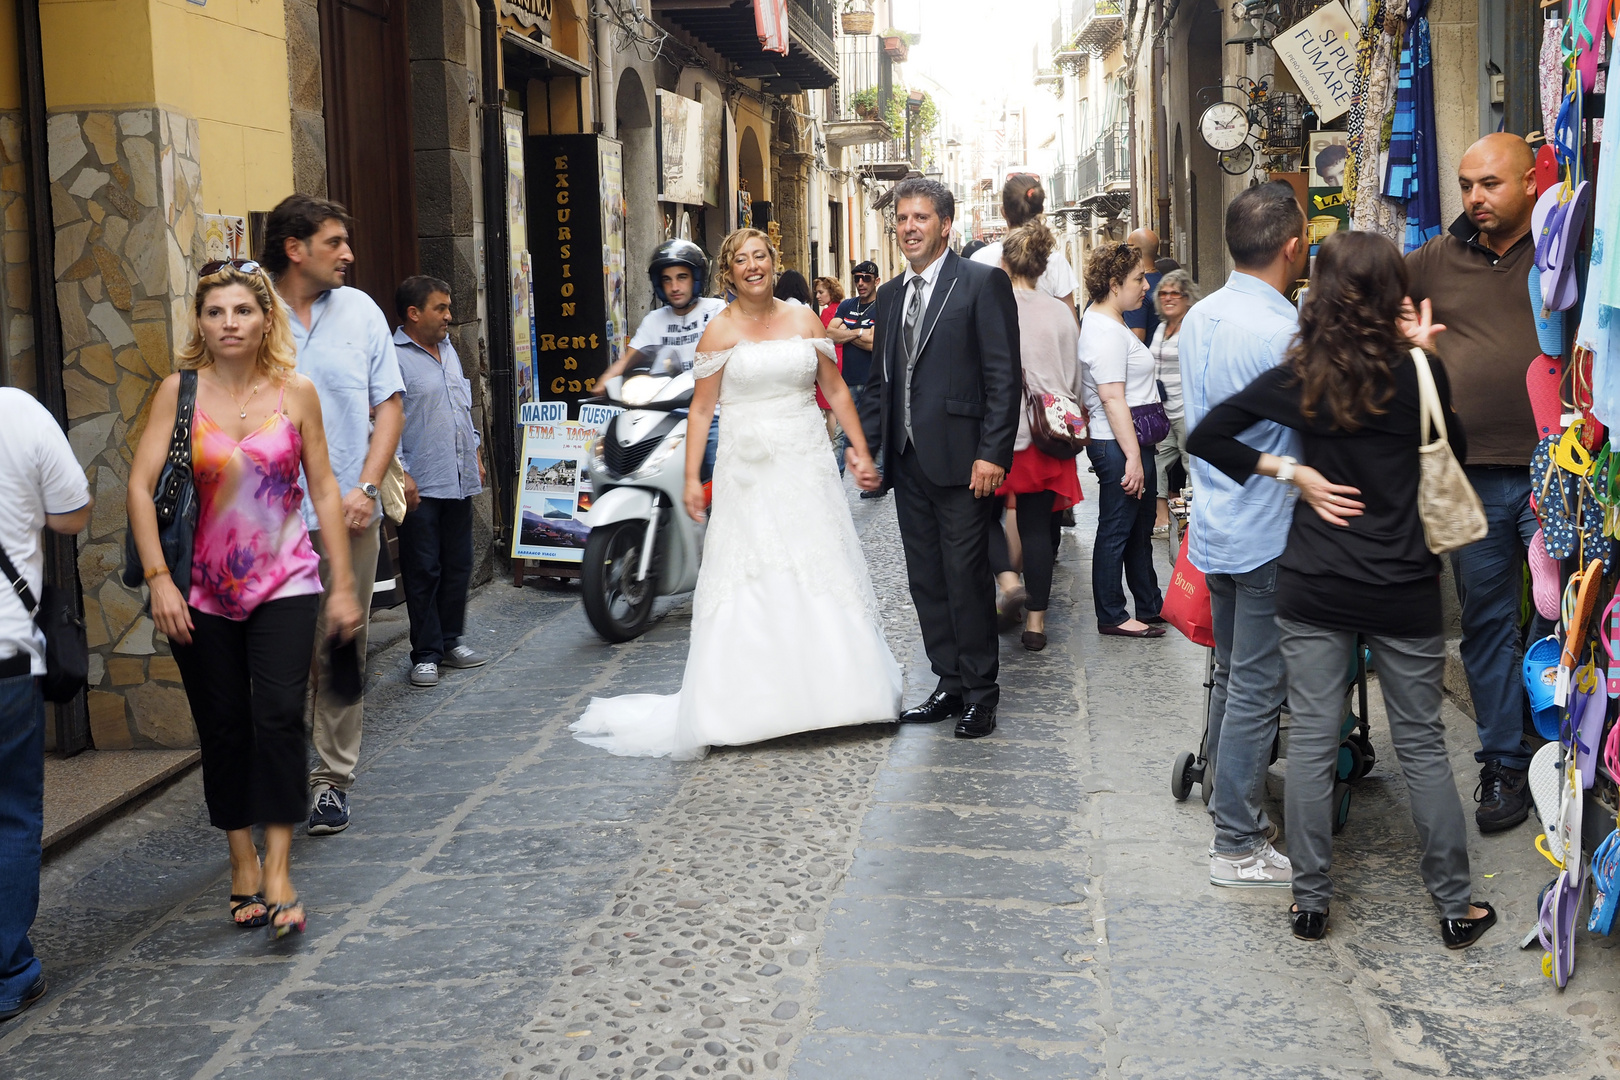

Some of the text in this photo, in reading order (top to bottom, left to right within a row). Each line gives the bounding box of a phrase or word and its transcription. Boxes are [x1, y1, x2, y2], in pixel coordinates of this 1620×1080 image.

[1318, 29, 1338, 48] SI
[1294, 28, 1352, 107] FUMARE
[1297, 69, 1310, 87] FUORI
[1307, 85, 1315, 95] DA
[553, 155, 577, 317] EXCURSION
[540, 333, 600, 352] Rent
[563, 356, 578, 370] a
[550, 376, 597, 394] Car
[522, 403, 565, 422] MARDI'
[528, 425, 556, 440] ETNA
[1175, 572, 1196, 595] Brums
